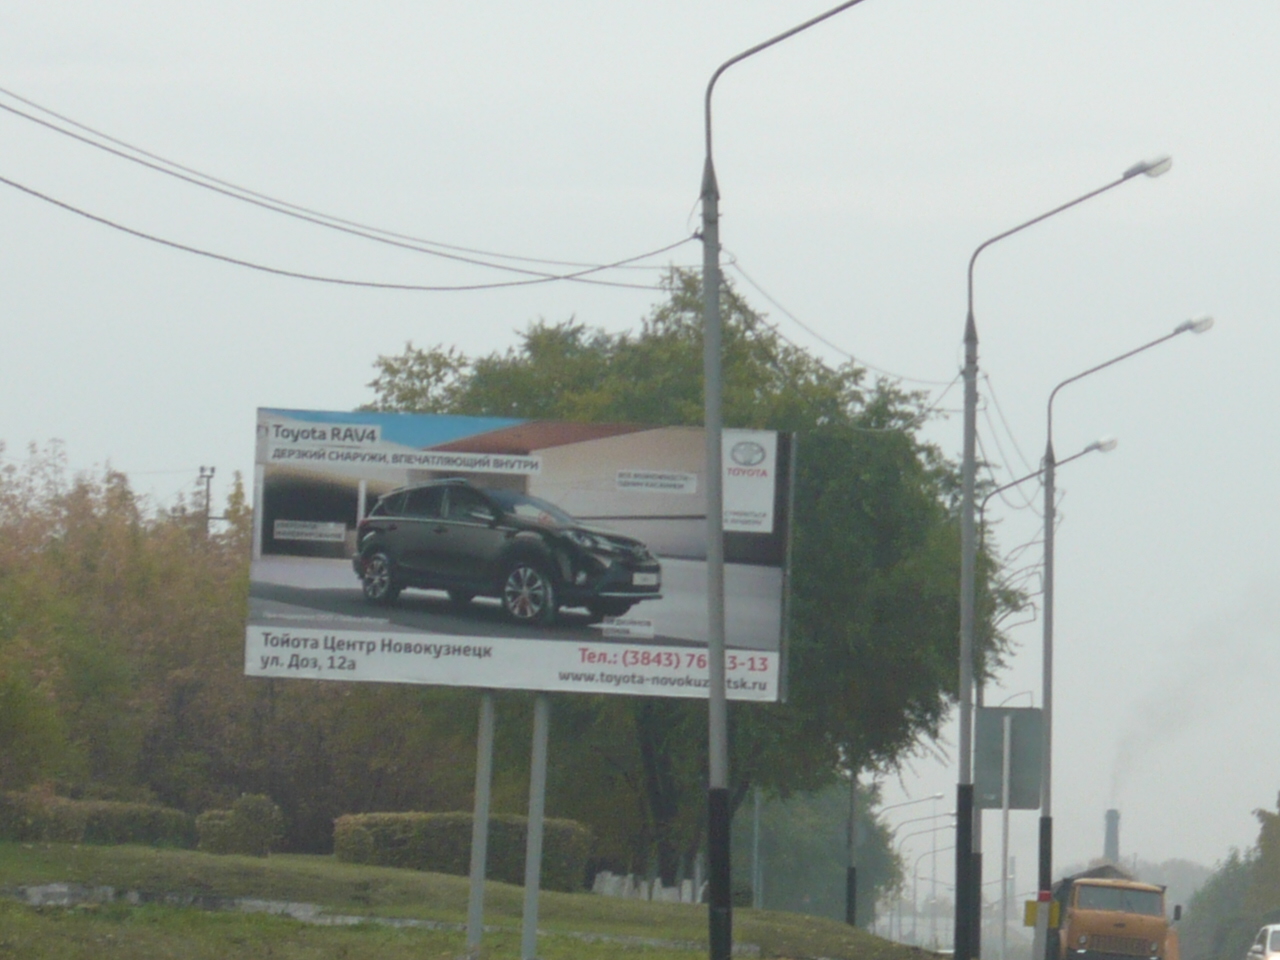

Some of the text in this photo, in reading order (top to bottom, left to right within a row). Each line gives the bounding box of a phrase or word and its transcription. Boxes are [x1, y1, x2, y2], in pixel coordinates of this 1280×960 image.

[272, 424, 378, 443] Toyota RAV4
[493, 458, 539, 470] ВНУТРИ
[727, 467, 768, 478] TOYOTA
[262, 632, 493, 659] Тойота Центр Новокузнецк
[260, 654, 357, 671] ул. Доз, 12а
[578, 647, 618, 664] Тел.:
[622, 650, 681, 669] (3843)
[558, 671, 767, 691] www.toyota-novokuztsk.ru
